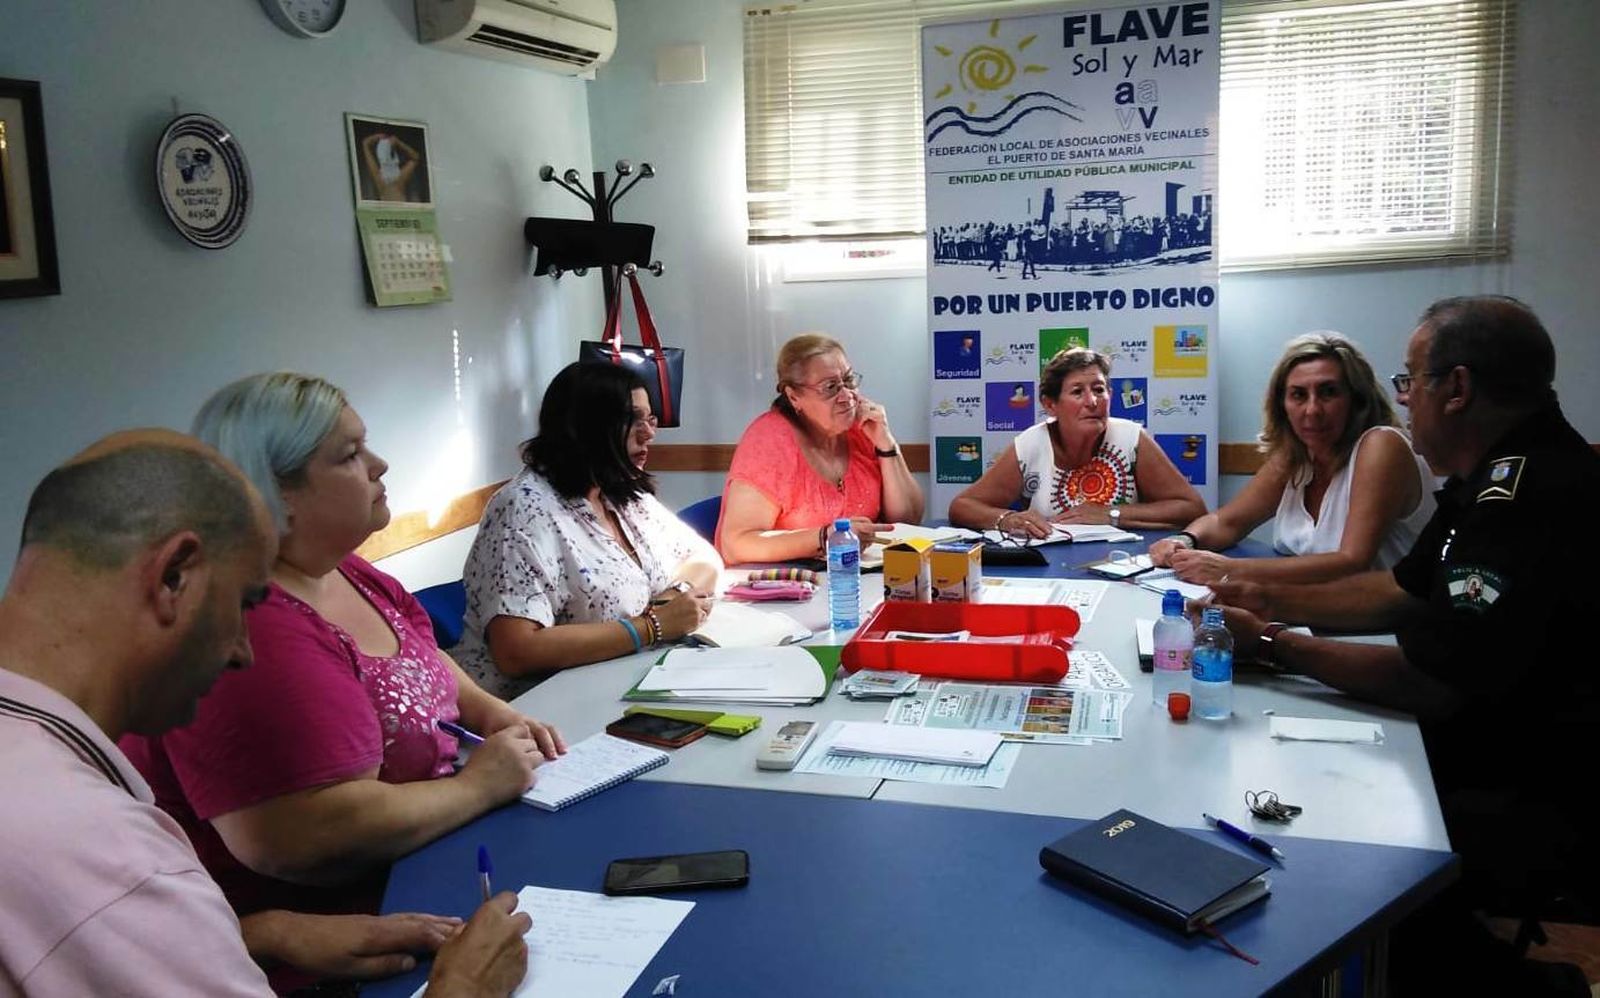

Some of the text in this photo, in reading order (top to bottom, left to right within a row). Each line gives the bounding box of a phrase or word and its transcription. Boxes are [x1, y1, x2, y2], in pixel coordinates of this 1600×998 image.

[1063, 2, 1209, 48] FLAVE
[1072, 44, 1203, 78] Sol y Mar
[1000, 141, 1037, 152] LOCAL
[1039, 139, 1054, 149] DE
[1056, 133, 1142, 148] ASOCIACIONES
[1144, 127, 1210, 141] VECINALES
[988, 144, 1145, 165] EL PUERTO DE SANTA MARÍA
[948, 160, 1196, 185] ENTIDAD DE UTILIDAD PÚBLICA MUNICIPAL
[933, 285, 1215, 316] POR UN PUERTO DIGNO
[1009, 343, 1035, 351] FLAVE
[1121, 340, 1147, 348] FLAVE
[936, 368, 980, 379] Seguridad
[956, 396, 981, 404] FLAVE
[1179, 394, 1207, 402] FLAVE
[987, 421, 1014, 430] Social
[1103, 819, 1136, 837] 2019
